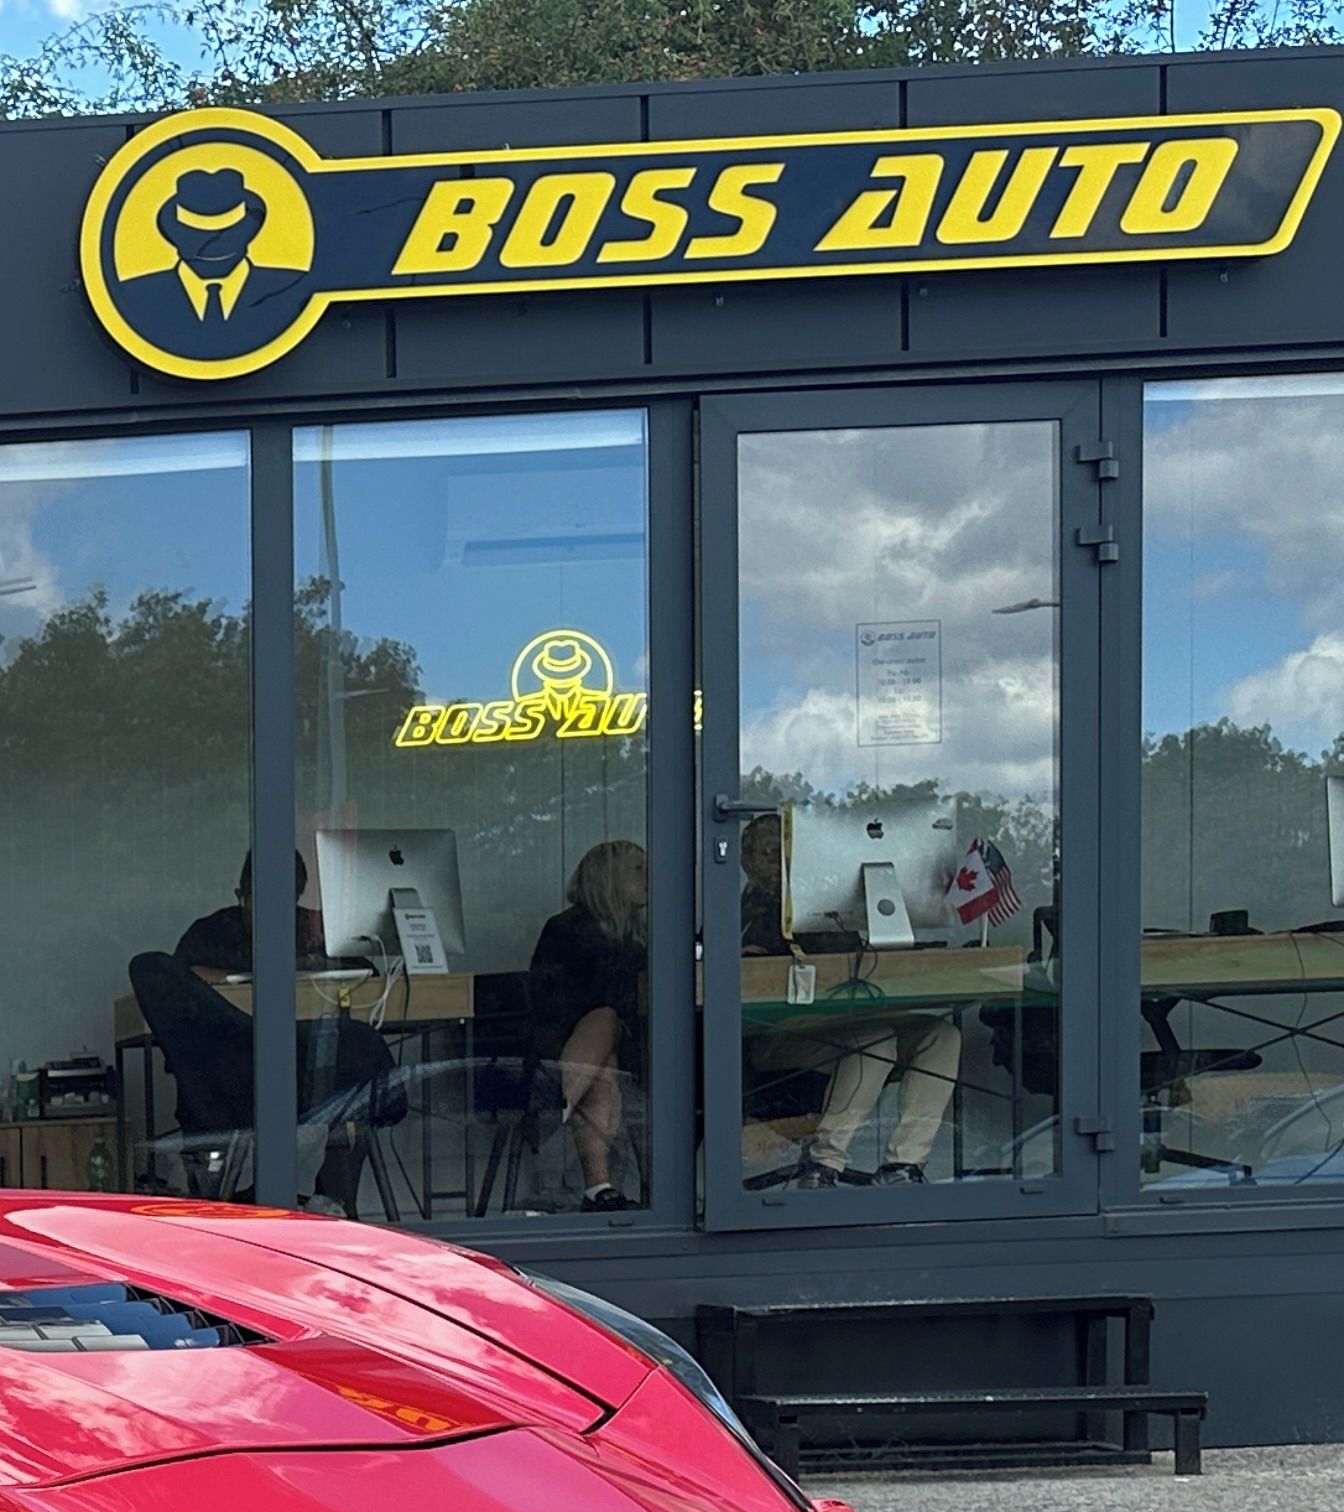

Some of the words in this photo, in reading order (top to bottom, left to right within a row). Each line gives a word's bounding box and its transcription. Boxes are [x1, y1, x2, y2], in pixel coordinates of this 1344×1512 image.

[391, 162, 786, 276] BOSS
[813, 136, 1239, 252] AUTO
[395, 701, 547, 747] BOSS
